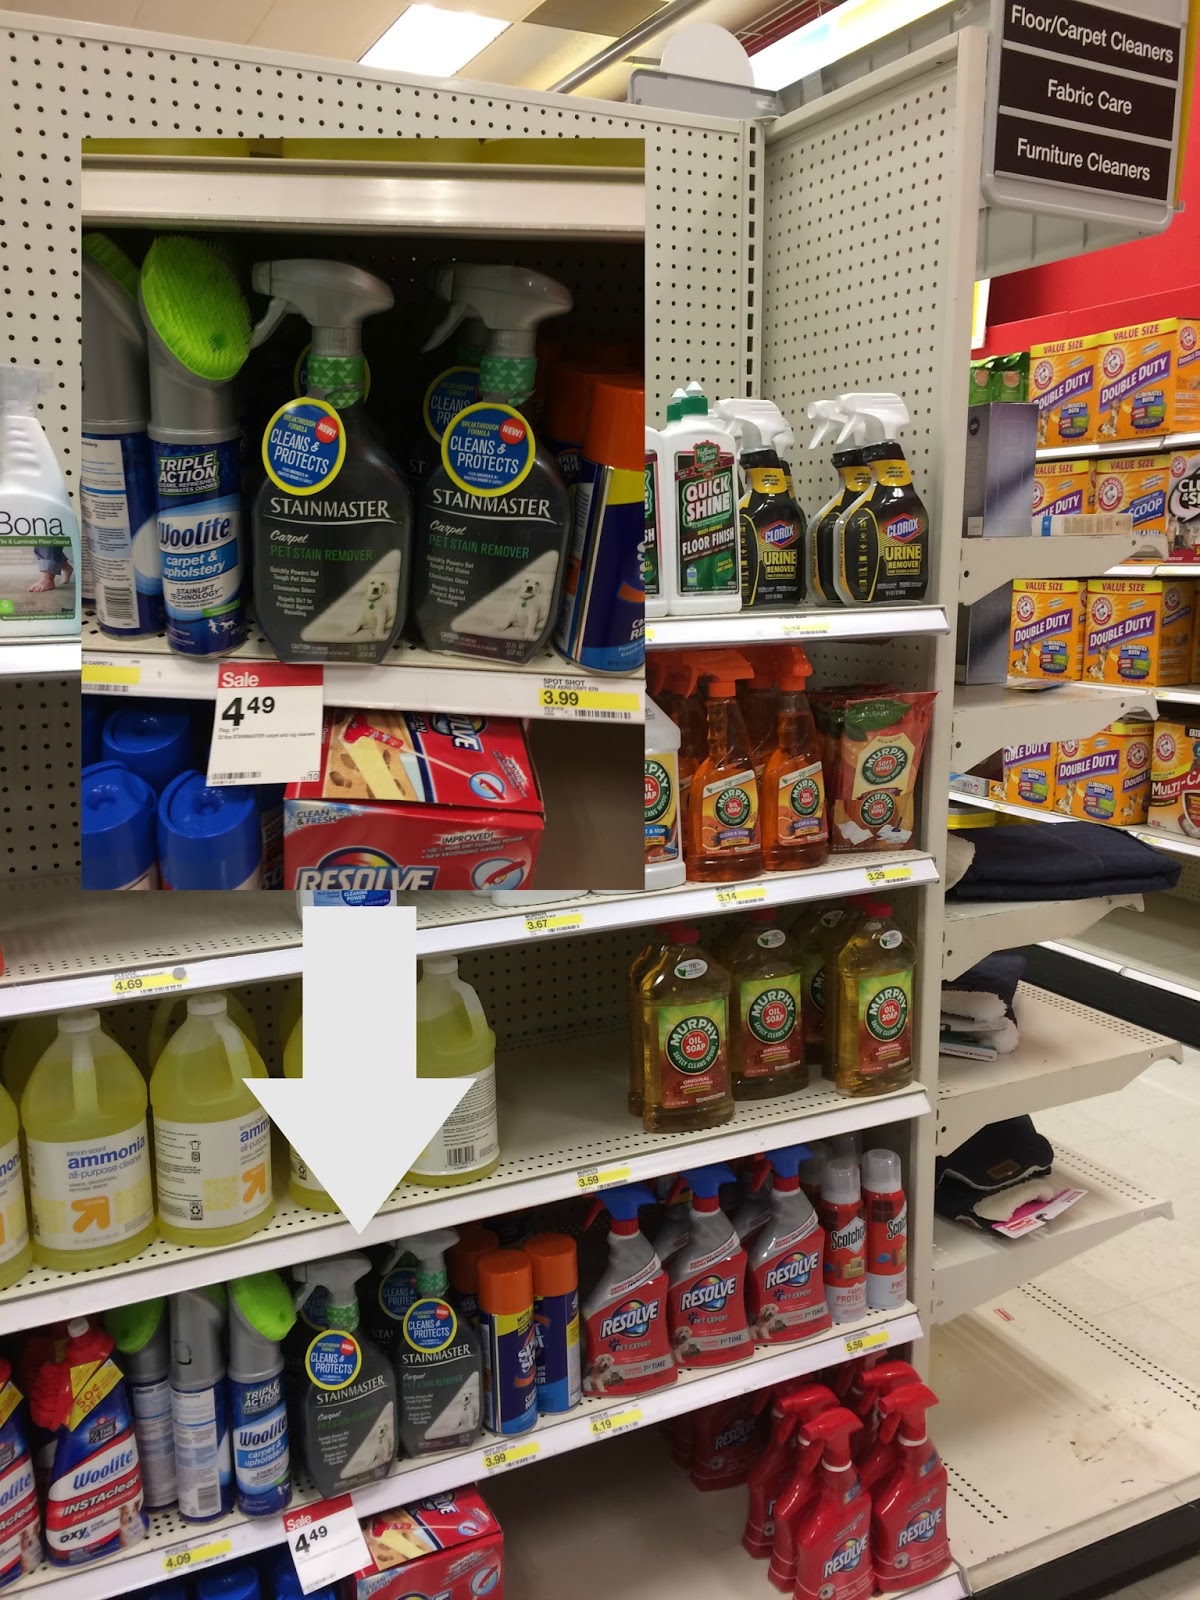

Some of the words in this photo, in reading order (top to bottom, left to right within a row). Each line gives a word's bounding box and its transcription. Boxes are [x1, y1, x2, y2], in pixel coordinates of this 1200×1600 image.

[1011, 4, 1108, 47] Floor/Carpet
[1110, 31, 1174, 63] Cleaners
[1047, 79, 1094, 106] Fabric
[1097, 91, 1133, 115] Care
[1017, 137, 1083, 168] Furniture
[1087, 152, 1151, 181] Cleaners
[1113, 328, 1139, 341] VALUE
[1141, 324, 1159, 336] SIZE
[1043, 342, 1066, 354] VALUE
[1068, 339, 1084, 350] SIZE
[1065, 370, 1091, 393] DUTY
[1101, 375, 1137, 404] DOUBLE
[1138, 356, 1168, 381] DUTY
[283, 413, 317, 428] BREAKTHROUGH
[287, 422, 308, 433] FORMULA
[461, 420, 500, 431] BREAKTHROUGH
[318, 421, 337, 438] NEW!
[467, 428, 490, 437] FORMULA
[502, 425, 524, 438] NEW!
[270, 428, 311, 452] CLEANS
[310, 440, 320, 452] &
[450, 436, 496, 455] CLEANS
[496, 443, 507, 454] &
[160, 453, 215, 471] TRIPLE
[274, 446, 330, 475] PROTECTS
[457, 452, 519, 474] PROTECTS
[1110, 460, 1135, 471] VALUE
[1137, 459, 1155, 469] SIZE
[160, 465, 218, 484] ACTION
[1035, 464, 1056, 476] VALUE
[1058, 463, 1073, 474] SIZE
[195, 482, 217, 491] ODORS
[685, 475, 729, 502] QUICK
[270, 497, 391, 519] STAINMASTER
[433, 489, 551, 519] STAINMASTER
[686, 491, 731, 522] SHINE
[1054, 495, 1080, 515] DUTY
[0, 511, 65, 536] Bona
[159, 516, 231, 547] Woolite
[430, 520, 467, 536] Carpet
[886, 517, 918, 538] CLOROX
[269, 529, 309, 546] Carpet
[682, 534, 710, 555] FLOOR
[712, 526, 735, 546] FINISH
[765, 525, 794, 543] CLOROX
[271, 544, 290, 557] PET
[293, 547, 321, 560] STAIN
[325, 549, 374, 561] REMOVER
[429, 534, 449, 547] PET
[450, 537, 478, 553] STAIN
[481, 542, 530, 559] REMOVER
[884, 545, 921, 560] URINE
[166, 553, 206, 569] carpet
[207, 550, 218, 562] &
[763, 551, 797, 565] URINE
[888, 560, 919, 569] REMOVER
[164, 560, 226, 578] upholstery
[767, 565, 795, 573] REMOVER
[170, 589, 220, 600] TECHNOLOGY
[176, 584, 216, 595] STAINLIFT
[1025, 581, 1047, 591] VALUE
[1048, 581, 1063, 591] SIZE
[1102, 581, 1126, 592] VALUE
[1128, 582, 1145, 592] SIZE
[1015, 622, 1045, 642] DOUBLE
[1046, 612, 1070, 629] DUTY
[1090, 625, 1123, 647] DOUBLE
[1125, 615, 1152, 634] DUTY
[221, 670, 260, 688] Sale
[543, 677, 564, 686] SPOT
[543, 690, 579, 706] 3.99
[865, 747, 907, 768] MURPHY
[1025, 742, 1048, 757] DUTY
[1060, 759, 1091, 777] DOUBLE
[1092, 753, 1117, 770] DUTY
[308, 771, 319, 781] 10
[792, 779, 818, 798] MURPHY
[717, 789, 749, 808] MURPHY
[863, 794, 893, 810] MURPHY
[296, 809, 330, 818] CLEAN
[305, 815, 337, 824] FRESH
[442, 831, 494, 845] IMPROVED!
[298, 867, 435, 890] RESOLVE
[867, 871, 886, 881] 3.29
[717, 891, 737, 902] 3.14
[526, 919, 548, 930] 3.67
[115, 979, 143, 990] 4.69
[751, 990, 795, 1018] MURPHY
[869, 988, 907, 1016] MURPHY
[884, 1005, 896, 1014] OIL
[766, 1014, 785, 1024] SOAP
[768, 1007, 781, 1016] OIL
[882, 1011, 898, 1021] SOAP
[670, 1018, 718, 1046] MURPHY
[688, 1036, 702, 1044] OIL
[685, 1043, 706, 1054] SOAP
[682, 1075, 710, 1085] ORIGINAL
[66, 1149, 87, 1157] lemon
[88, 1145, 107, 1154] scent
[67, 1135, 146, 1170] ammonia
[68, 1164, 118, 1181] all-purpose
[578, 1175, 599, 1187] 3.59
[765, 1251, 819, 1289] RESOLVE
[681, 1277, 737, 1312] RESOLVE
[791, 1288, 812, 1299] EXPERT
[811, 1305, 824, 1316] TIME
[407, 1319, 435, 1331] CLEANS
[601, 1300, 659, 1339] RESOLVE
[693, 1317, 705, 1325] PET
[705, 1314, 729, 1324] EXPERT
[413, 1327, 450, 1339] PROTECTS
[728, 1334, 742, 1344] TIME
[628, 1340, 651, 1350] EXPERT
[846, 1339, 863, 1352] 5.59
[310, 1352, 339, 1363] CLEANS
[401, 1343, 471, 1365] STAINMASTER
[315, 1362, 353, 1375] PROTECTS
[651, 1360, 666, 1370] TIME
[244, 1386, 280, 1408] ACTION
[246, 1380, 279, 1401] TRIPLE
[316, 1374, 386, 1405] STAINMASTER
[82, 1391, 104, 1413] OFF
[592, 1419, 612, 1432] 4.19
[248, 1442, 276, 1459] carpet
[485, 1452, 507, 1468] 3.99
[73, 1450, 134, 1490] Woolite
[62, 1473, 140, 1517] INSTAclear
[286, 1512, 312, 1532] Sale
[898, 1508, 943, 1549] RESOLVE
[60, 1527, 88, 1543] oxy
[166, 1552, 191, 1568] 4.09
[823, 1533, 869, 1580] RESOLVE
